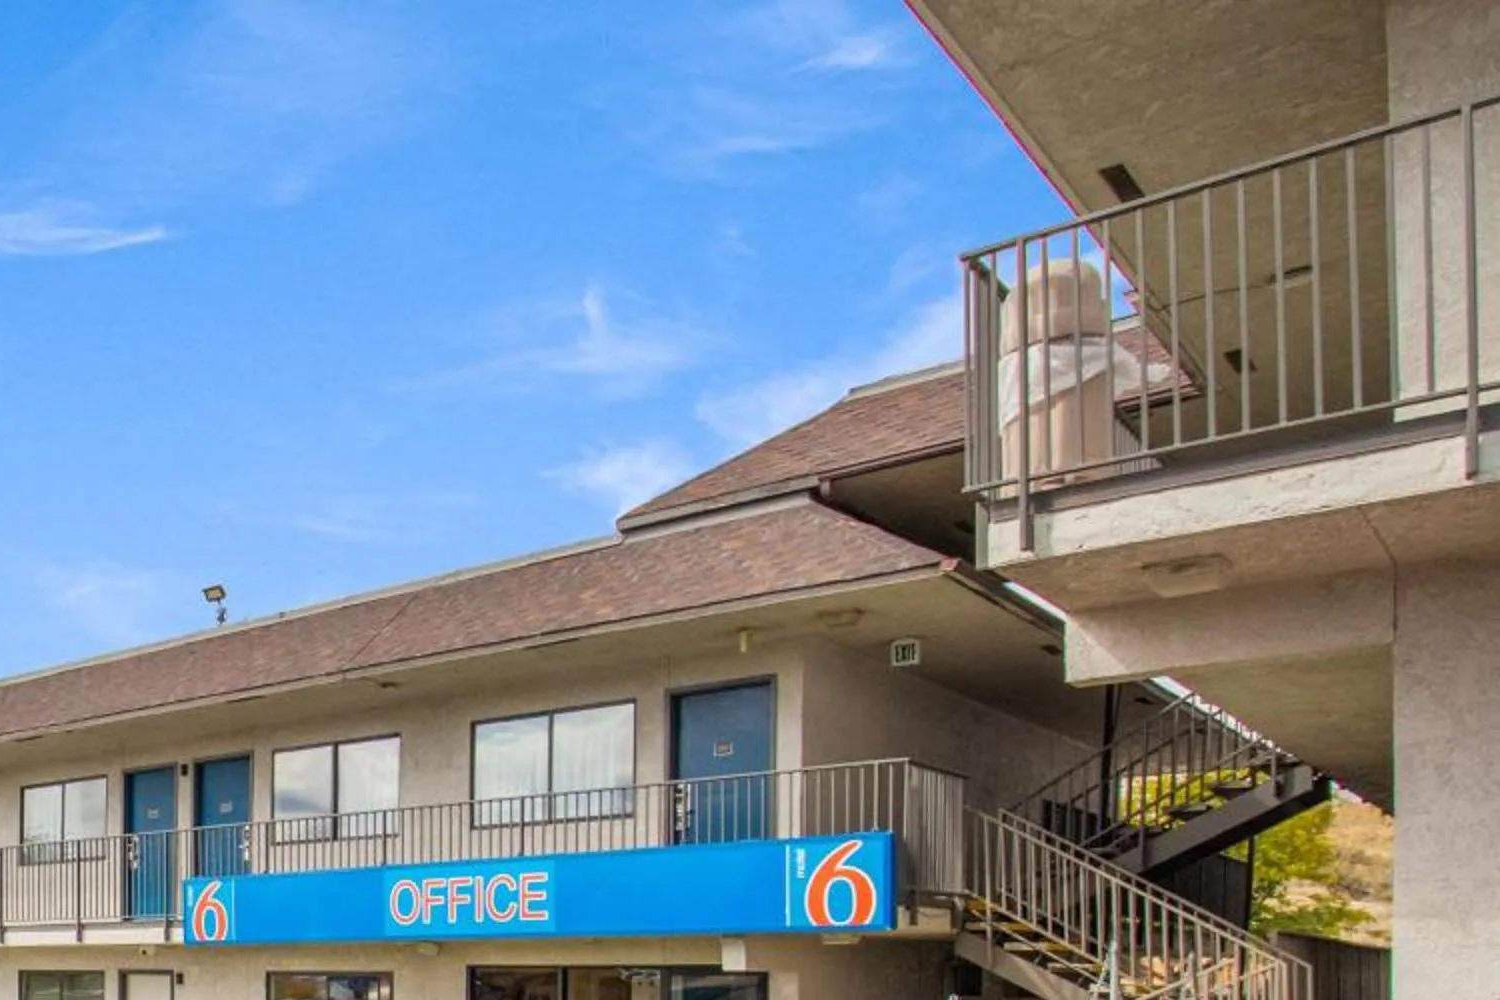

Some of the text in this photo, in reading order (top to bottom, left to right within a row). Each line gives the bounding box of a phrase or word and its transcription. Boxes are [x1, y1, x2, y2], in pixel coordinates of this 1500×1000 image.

[192, 880, 228, 941] 6
[390, 872, 548, 925] OFFICE
[804, 840, 877, 927] 6
